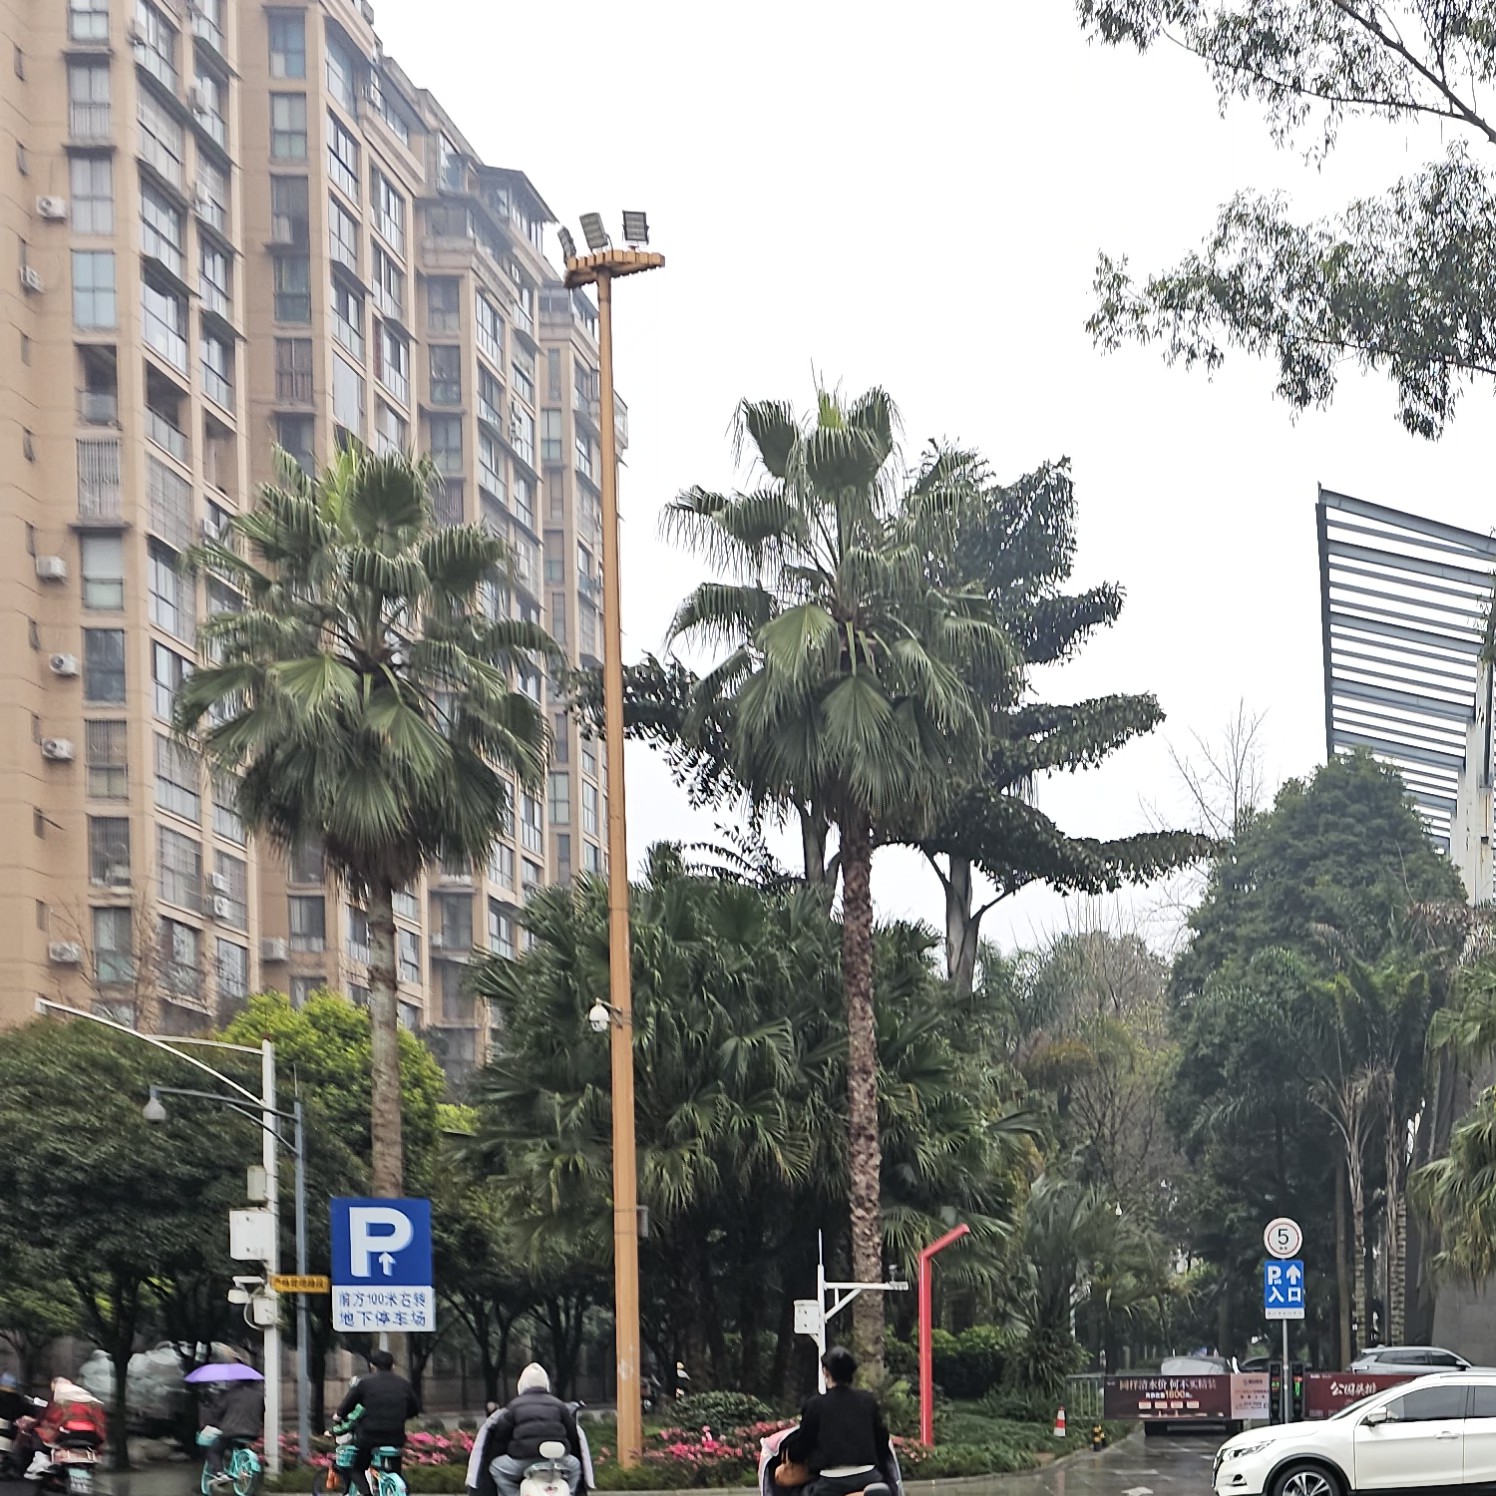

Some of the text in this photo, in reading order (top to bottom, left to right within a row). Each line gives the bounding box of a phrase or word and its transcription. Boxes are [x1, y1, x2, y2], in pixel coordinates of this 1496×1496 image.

[349, 1206, 413, 1278] P
[1278, 1228, 1289, 1246] 5
[1267, 1265, 1282, 1286] P
[339, 1291, 426, 1308] 前方100米右转
[1268, 1286, 1302, 1303] 入口
[340, 1310, 426, 1328] 地下停车场
